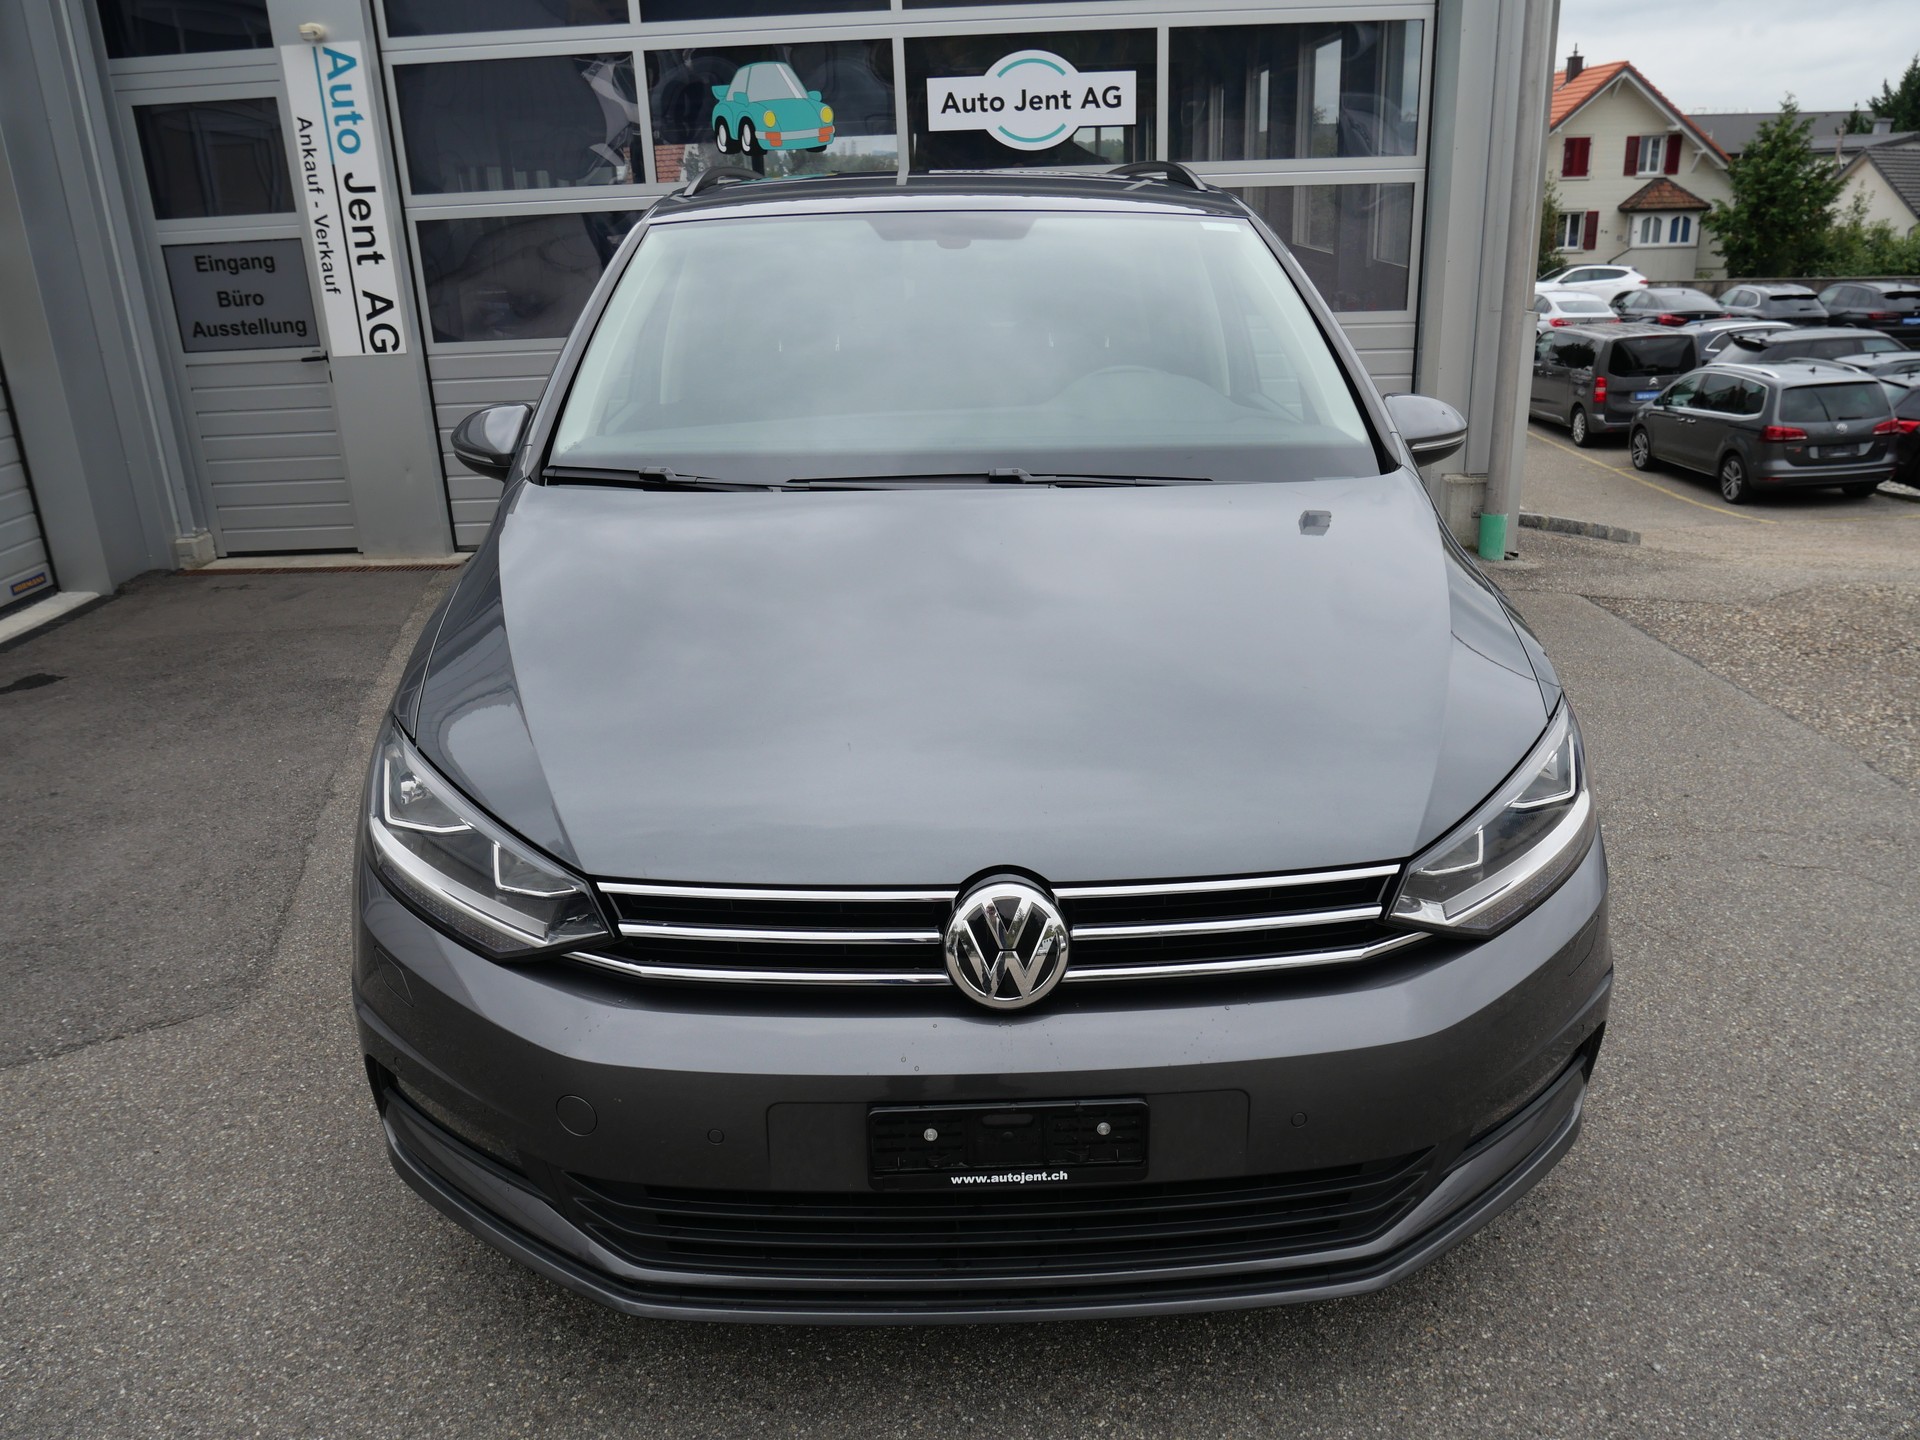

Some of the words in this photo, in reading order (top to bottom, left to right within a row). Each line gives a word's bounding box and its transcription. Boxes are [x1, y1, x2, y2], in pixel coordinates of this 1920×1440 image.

[322, 46, 365, 155] Auto
[940, 91, 1005, 114] Auto
[1013, 88, 1072, 112] Jent
[1080, 85, 1122, 109] AG
[296, 116, 325, 195] Ankauf
[313, 213, 342, 295] Verkauf
[343, 172, 386, 266] Jent
[193, 254, 276, 275] Eingang
[216, 289, 265, 308] Büro
[192, 317, 308, 337] Ausstellung
[361, 289, 401, 354] AG
[950, 1170, 1069, 1185] www.autojent.ch
